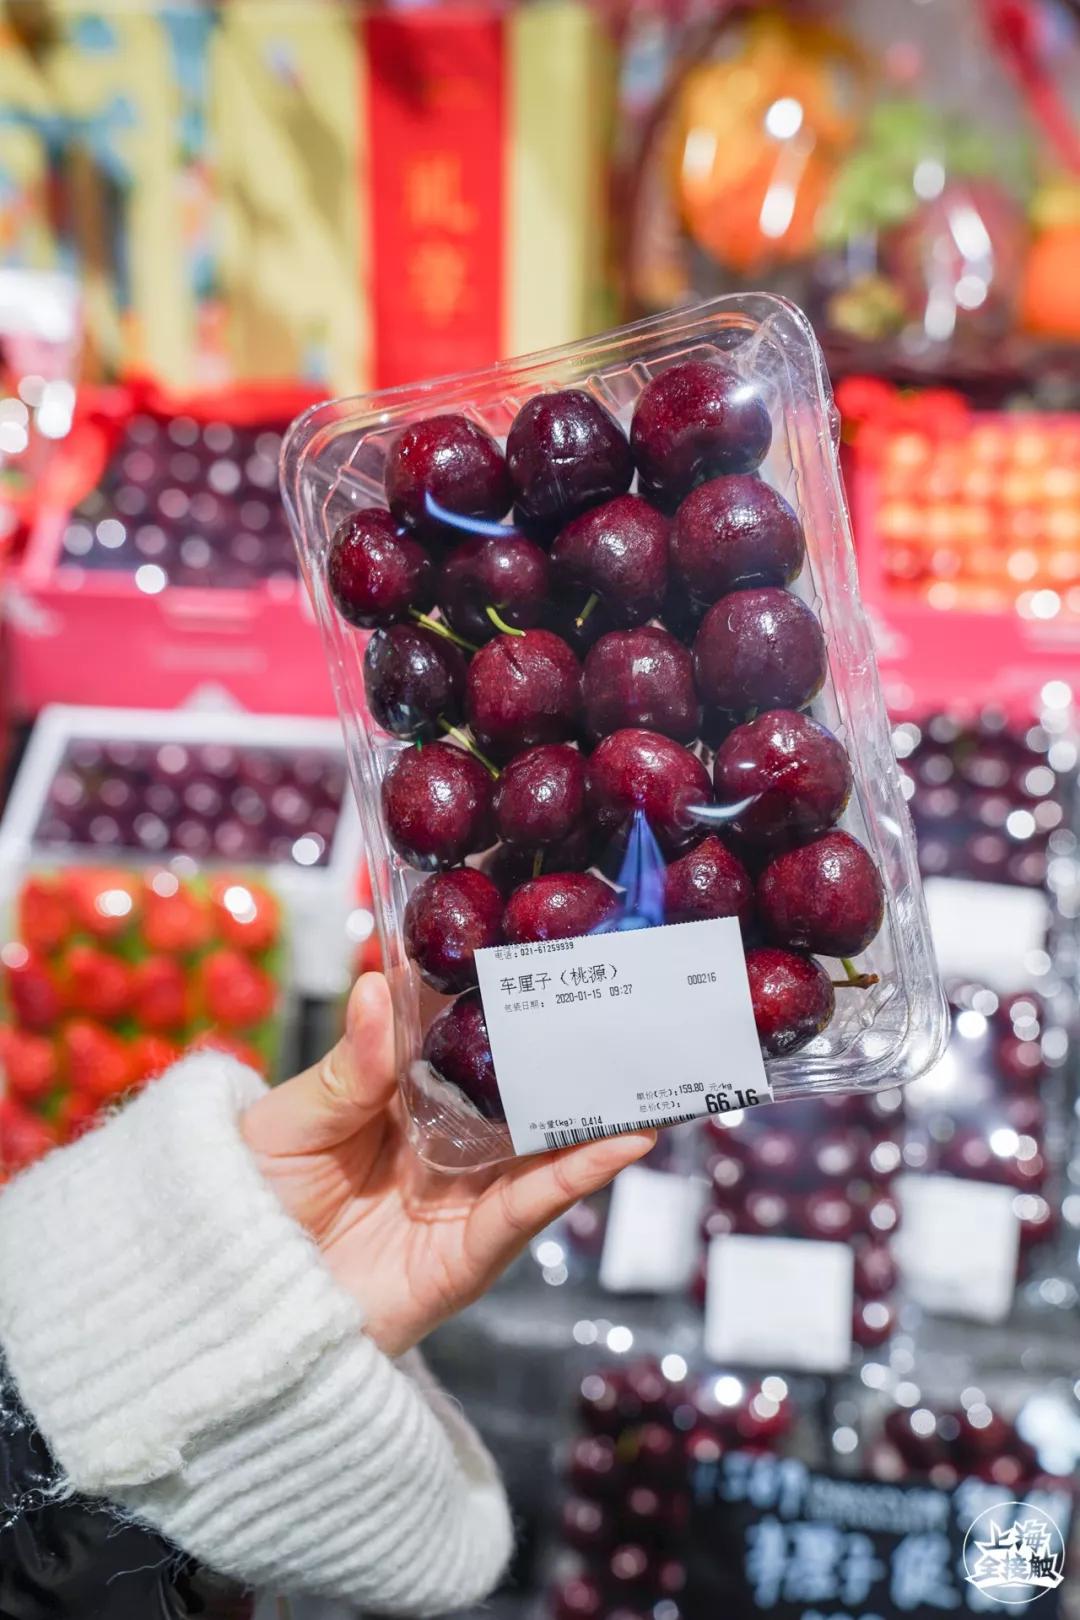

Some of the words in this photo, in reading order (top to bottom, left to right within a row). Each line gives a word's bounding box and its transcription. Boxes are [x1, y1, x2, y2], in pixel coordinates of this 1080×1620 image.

[687, 972, 717, 985] 000216
[556, 988, 602, 1004] 2020-01-15
[609, 984, 633, 997] 09:27
[705, 1089, 759, 1114] 66.16
[581, 1115, 603, 1127] 0.414
